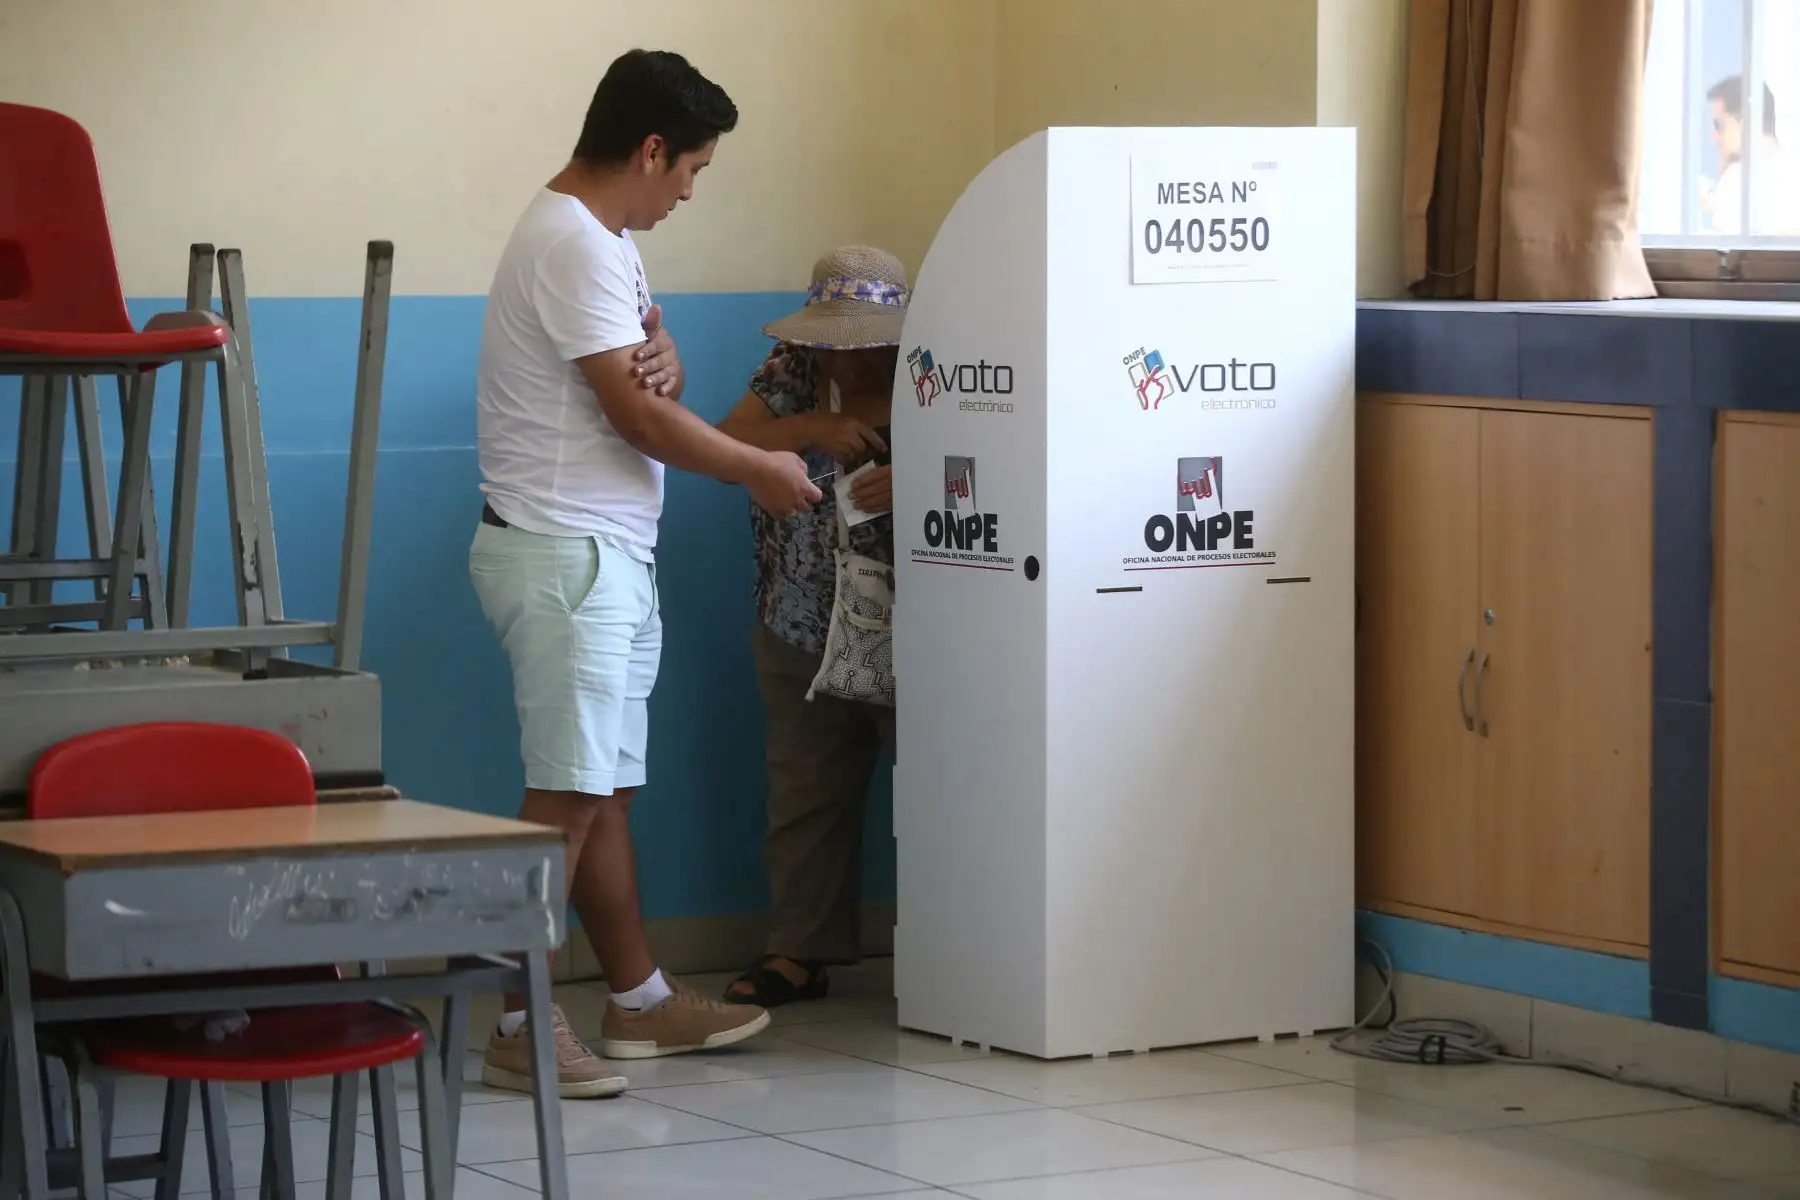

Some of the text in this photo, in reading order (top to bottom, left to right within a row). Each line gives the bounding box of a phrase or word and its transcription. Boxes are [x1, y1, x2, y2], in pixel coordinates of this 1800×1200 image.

[1157, 181, 1224, 204] MESA
[1144, 216, 1270, 254] 040550
[1122, 346, 1147, 366] ONPE
[938, 359, 1013, 394] voto
[1170, 357, 1276, 393] voto
[924, 508, 998, 553] ONPE
[1144, 510, 1254, 553] ONPE
[911, 549, 1014, 564] OFICINA NACIONAL DE PROCESOS ELECTORALES
[1123, 551, 1277, 565] OFICINA NACIONAL DE PROCESOS ELECTORALES
